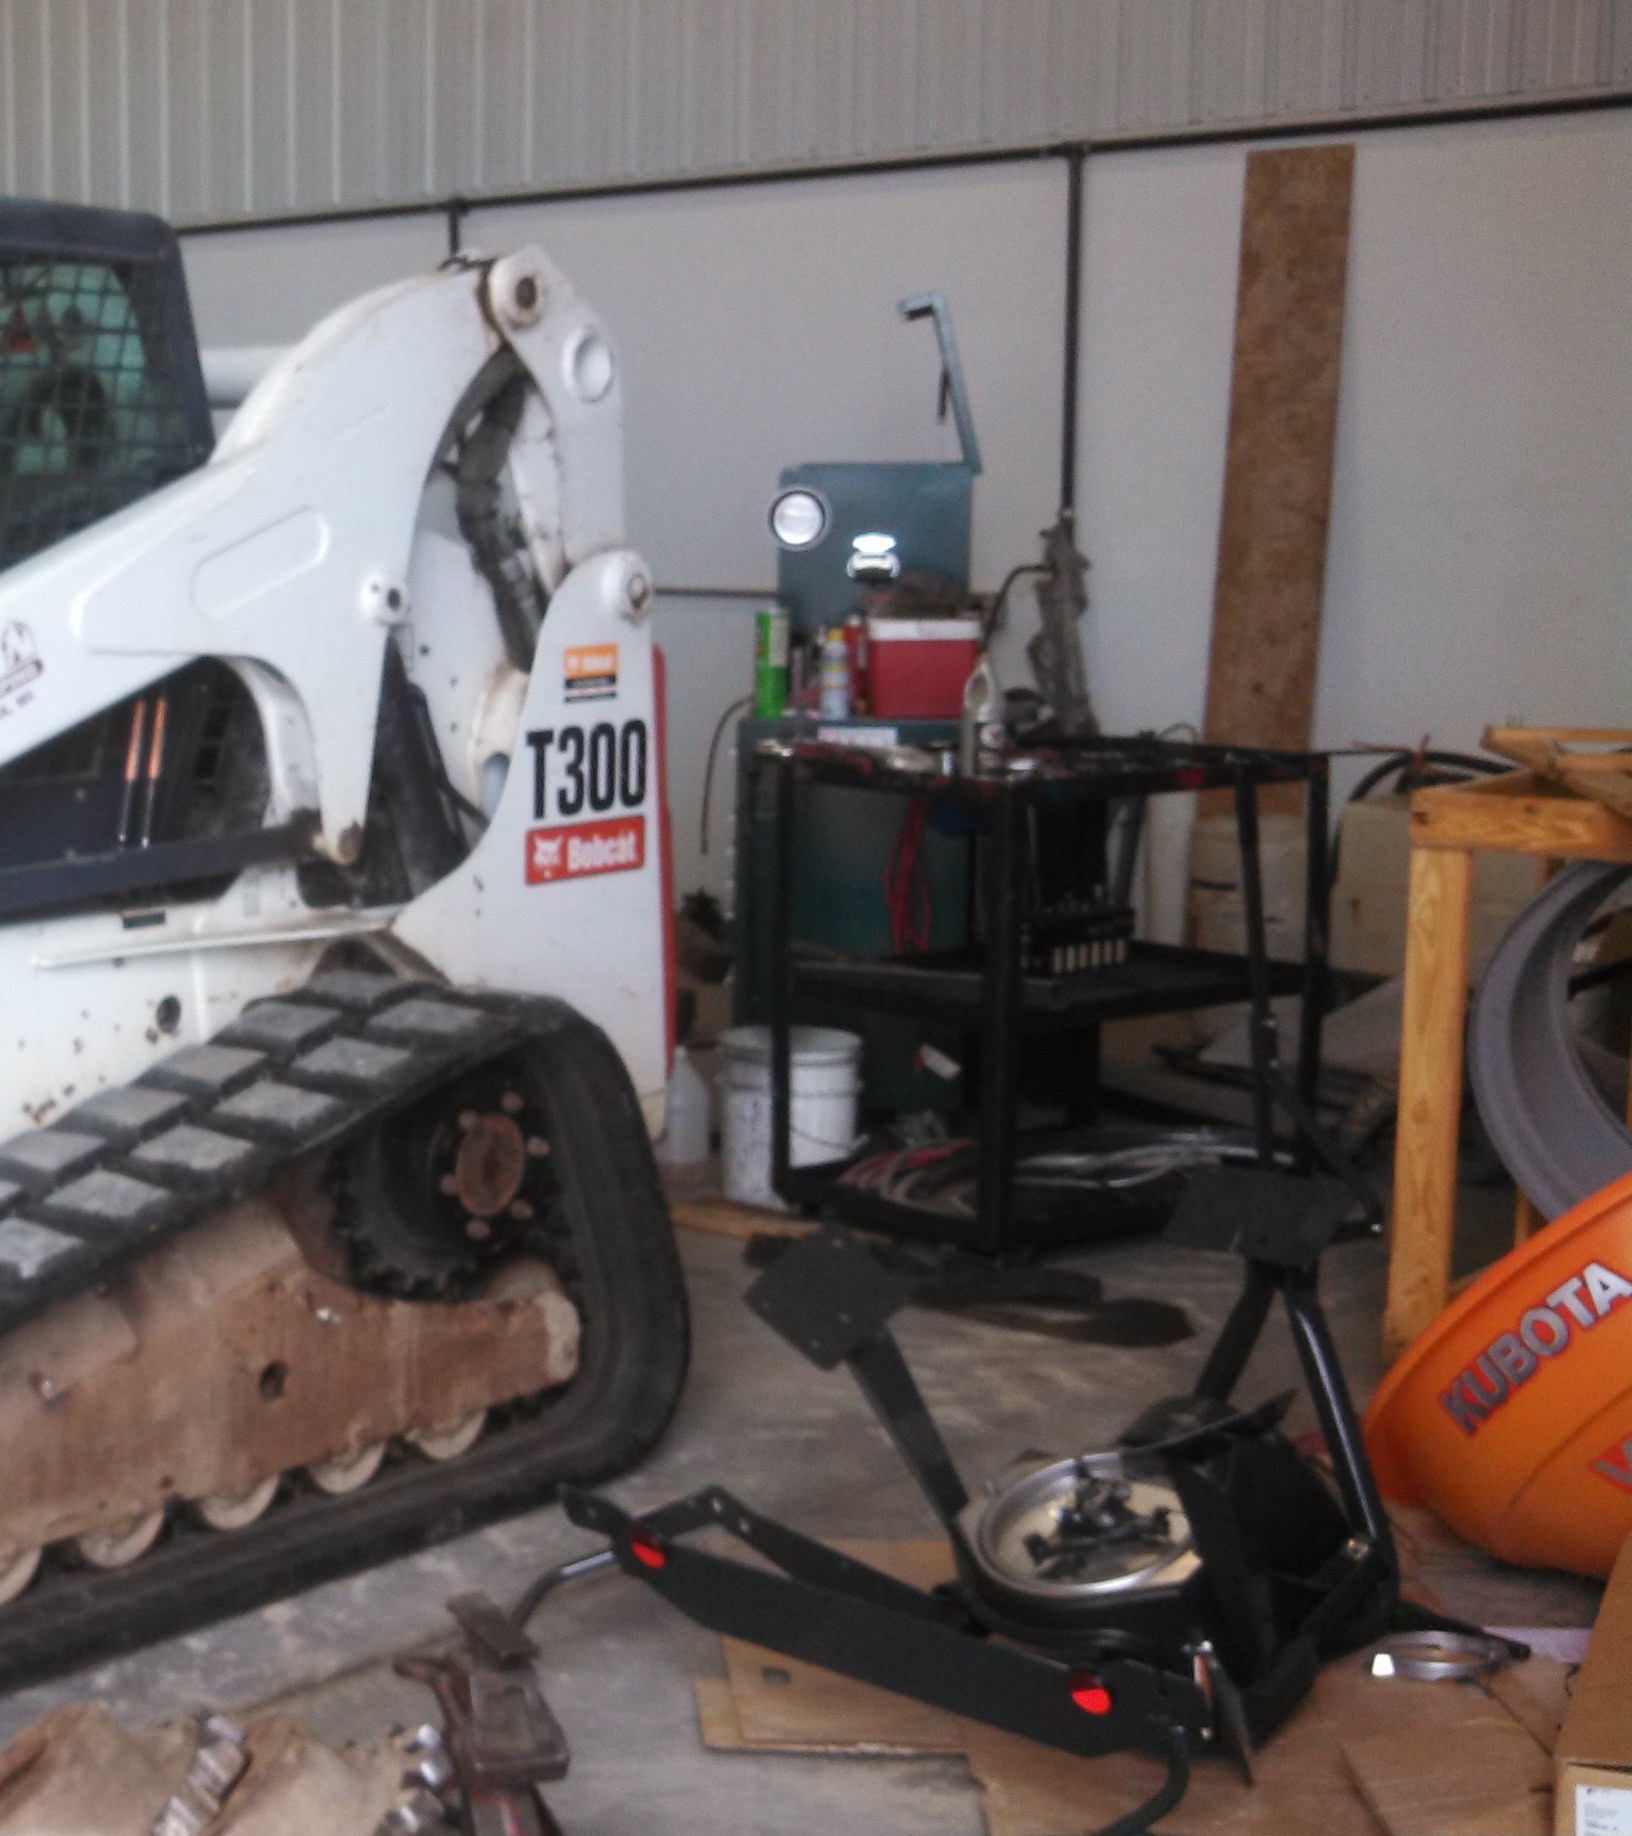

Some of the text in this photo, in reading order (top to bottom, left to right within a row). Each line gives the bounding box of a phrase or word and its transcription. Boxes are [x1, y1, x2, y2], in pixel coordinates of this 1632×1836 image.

[527, 719, 646, 820] T300
[568, 831, 637, 872] Bobcat
[1440, 1262, 1632, 1434] KUBOTA
